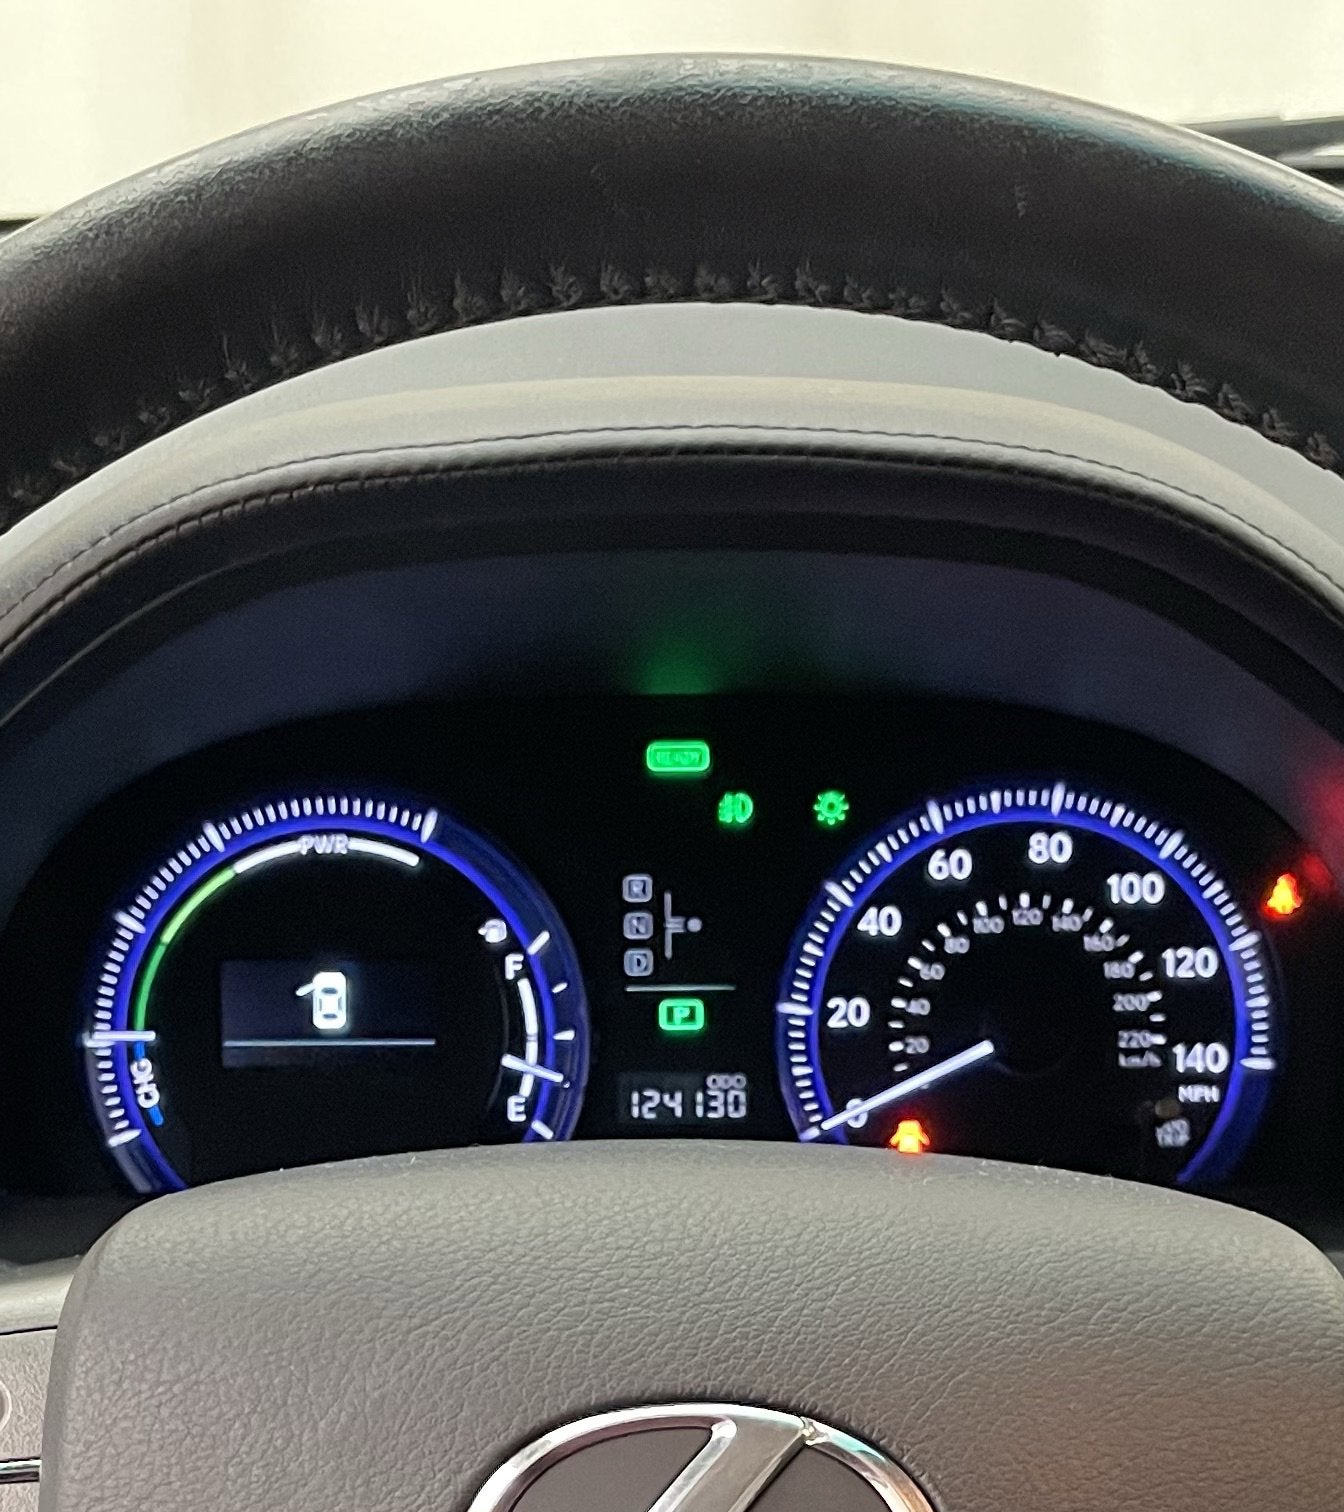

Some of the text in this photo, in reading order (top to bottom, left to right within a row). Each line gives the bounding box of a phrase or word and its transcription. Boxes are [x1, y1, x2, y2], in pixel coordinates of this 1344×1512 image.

[1027, 831, 1074, 863] 80
[927, 848, 973, 880] 60
[1106, 871, 1167, 905] 100
[856, 905, 903, 937] 40
[504, 953, 524, 980] F
[1161, 946, 1220, 979] 120
[825, 996, 871, 1028] 20
[1172, 1042, 1231, 1074] 140
[1177, 1083, 1222, 1103] MPH
[506, 1097, 528, 1123] E
